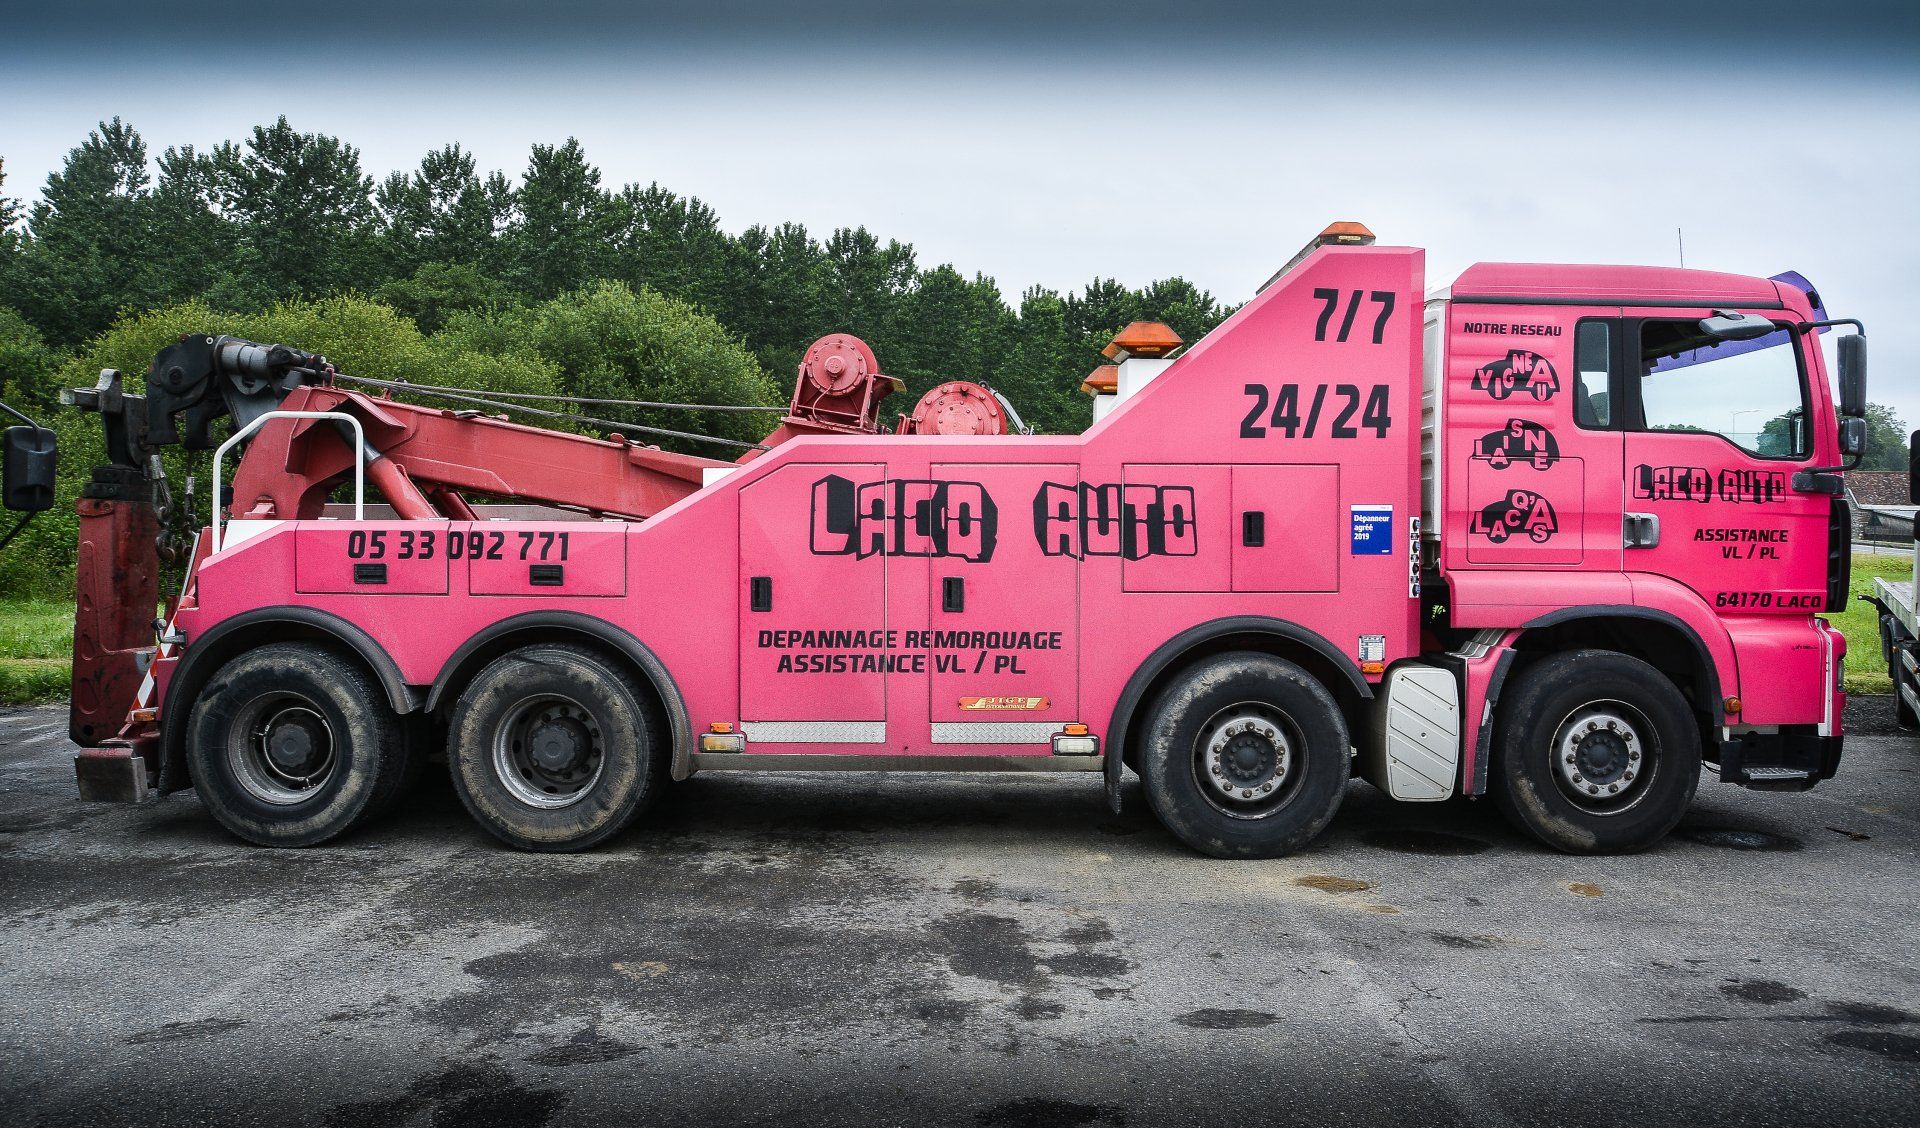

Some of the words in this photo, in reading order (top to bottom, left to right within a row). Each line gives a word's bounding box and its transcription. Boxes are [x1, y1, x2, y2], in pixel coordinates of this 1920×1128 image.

[1313, 288, 1396, 344] 7/7
[1464, 322, 1507, 334] NOTRE
[1511, 324, 1562, 336] RESEAU
[1240, 384, 1391, 438] 24/24
[1633, 464, 1712, 503] LACQ
[1718, 469, 1786, 504] AUTO
[809, 474, 998, 563] LACQ
[1033, 481, 1198, 561] AUTO
[1353, 514, 1390, 523] Dépanneur
[1353, 523, 1374, 532] agréé
[1353, 532, 1370, 540] 2019
[1694, 528, 1788, 542] ASSISTANCE
[348, 530, 387, 559] 05
[398, 530, 435, 560] 33
[449, 531, 505, 560] 092
[518, 531, 569, 561] 771
[1722, 546, 1743, 559] VL
[1759, 546, 1780, 559] PL
[1715, 592, 1772, 608] 64170
[1776, 595, 1821, 608] LACQ
[758, 630, 898, 648] DEPANNAGE
[904, 630, 1063, 650] REMORQUAGE
[777, 654, 925, 674] ASSISTANCE
[935, 655, 966, 673] VL
[993, 655, 1026, 674] PL
